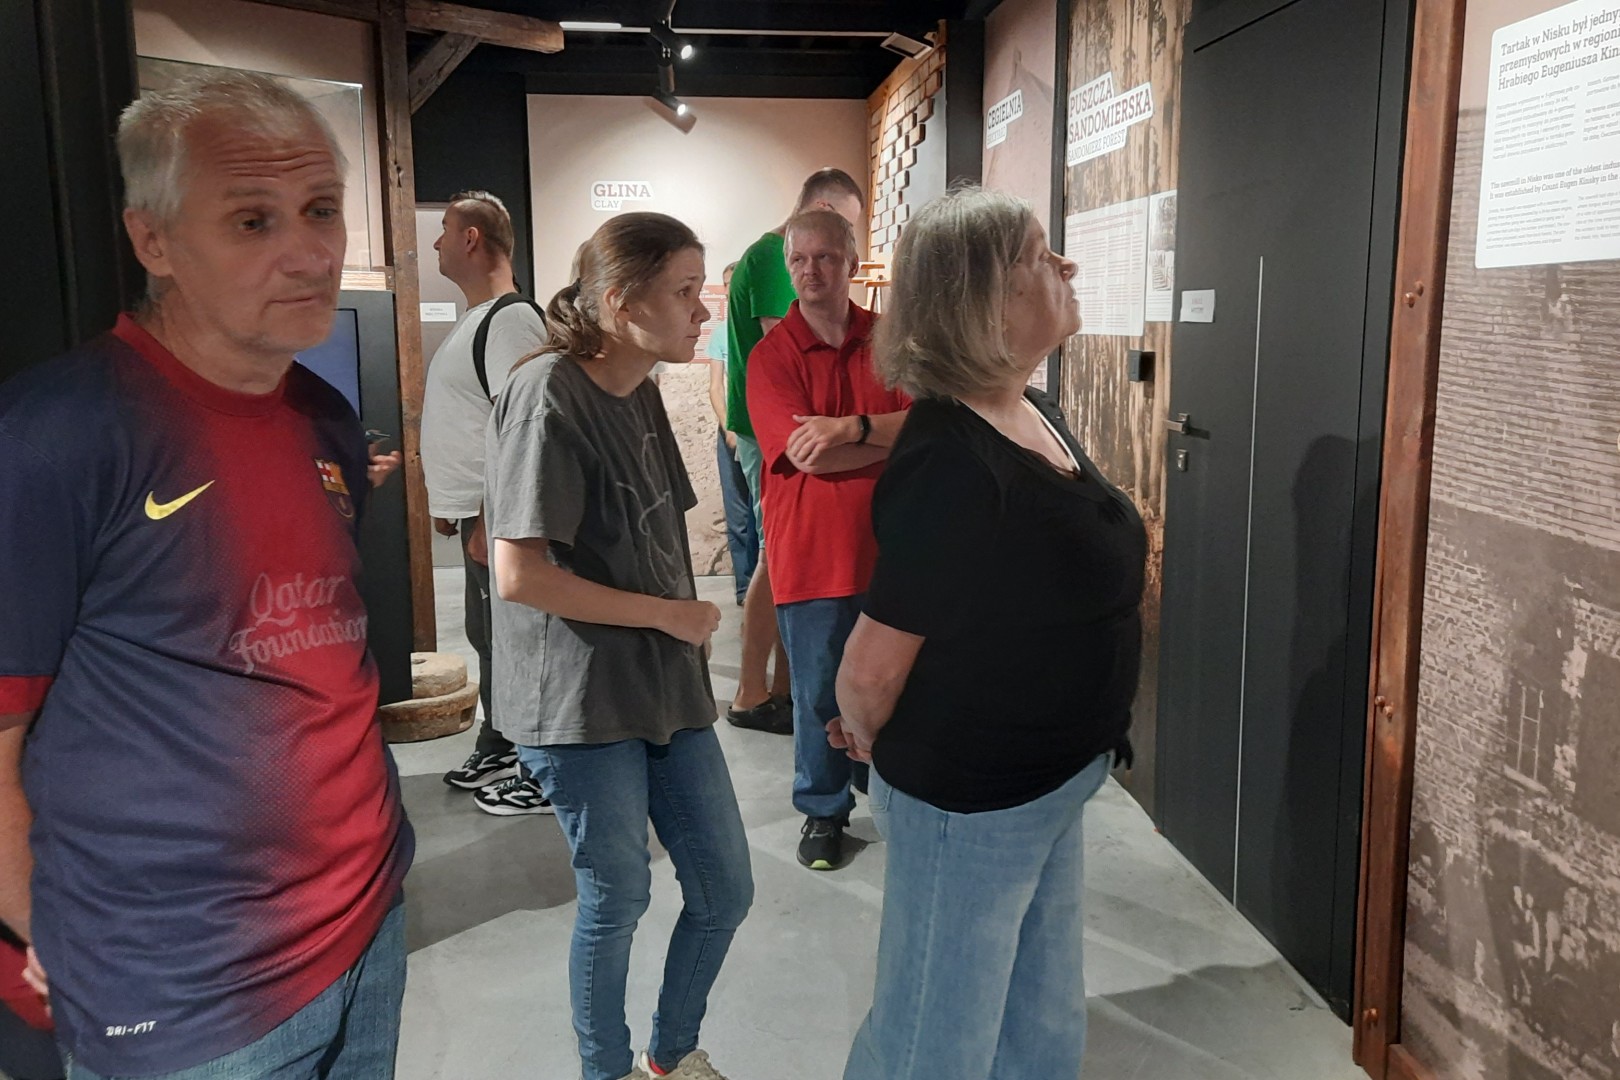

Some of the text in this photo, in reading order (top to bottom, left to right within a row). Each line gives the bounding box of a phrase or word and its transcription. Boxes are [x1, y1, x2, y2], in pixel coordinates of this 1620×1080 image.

[1501, 9, 1620, 56] Tartak w Nisku był jedny
[1498, 46, 1620, 91] Hrabiego Eugeniusza Kin
[1499, 40, 1571, 77] przemysłowych
[1572, 38, 1582, 50] w
[987, 94, 1022, 130] CEGIELNIA
[1069, 77, 1113, 118] PUSZCZA
[1069, 88, 1151, 144] SANDOMIERSKA
[1068, 129, 1125, 162] SANDOMIERZ FOREST
[593, 183, 651, 198] GLINA
[1489, 190, 1494, 200] It
[1504, 185, 1533, 197] established
[1534, 184, 1541, 194] by
[1541, 182, 1558, 191] Count
[1560, 180, 1578, 190] Eugen
[1579, 175, 1600, 185] Kinsky
[1607, 172, 1618, 180] the
[1491, 181, 1500, 190] The
[1527, 173, 1542, 184] Nisko
[1566, 167, 1572, 176] of
[1573, 166, 1582, 175] the
[1583, 164, 1601, 173] oldest
[594, 199, 620, 209] CLAY
[249, 572, 346, 627] Qatar
[228, 609, 368, 675] Foundation
[105, 1020, 157, 1037] DRI-FIT
